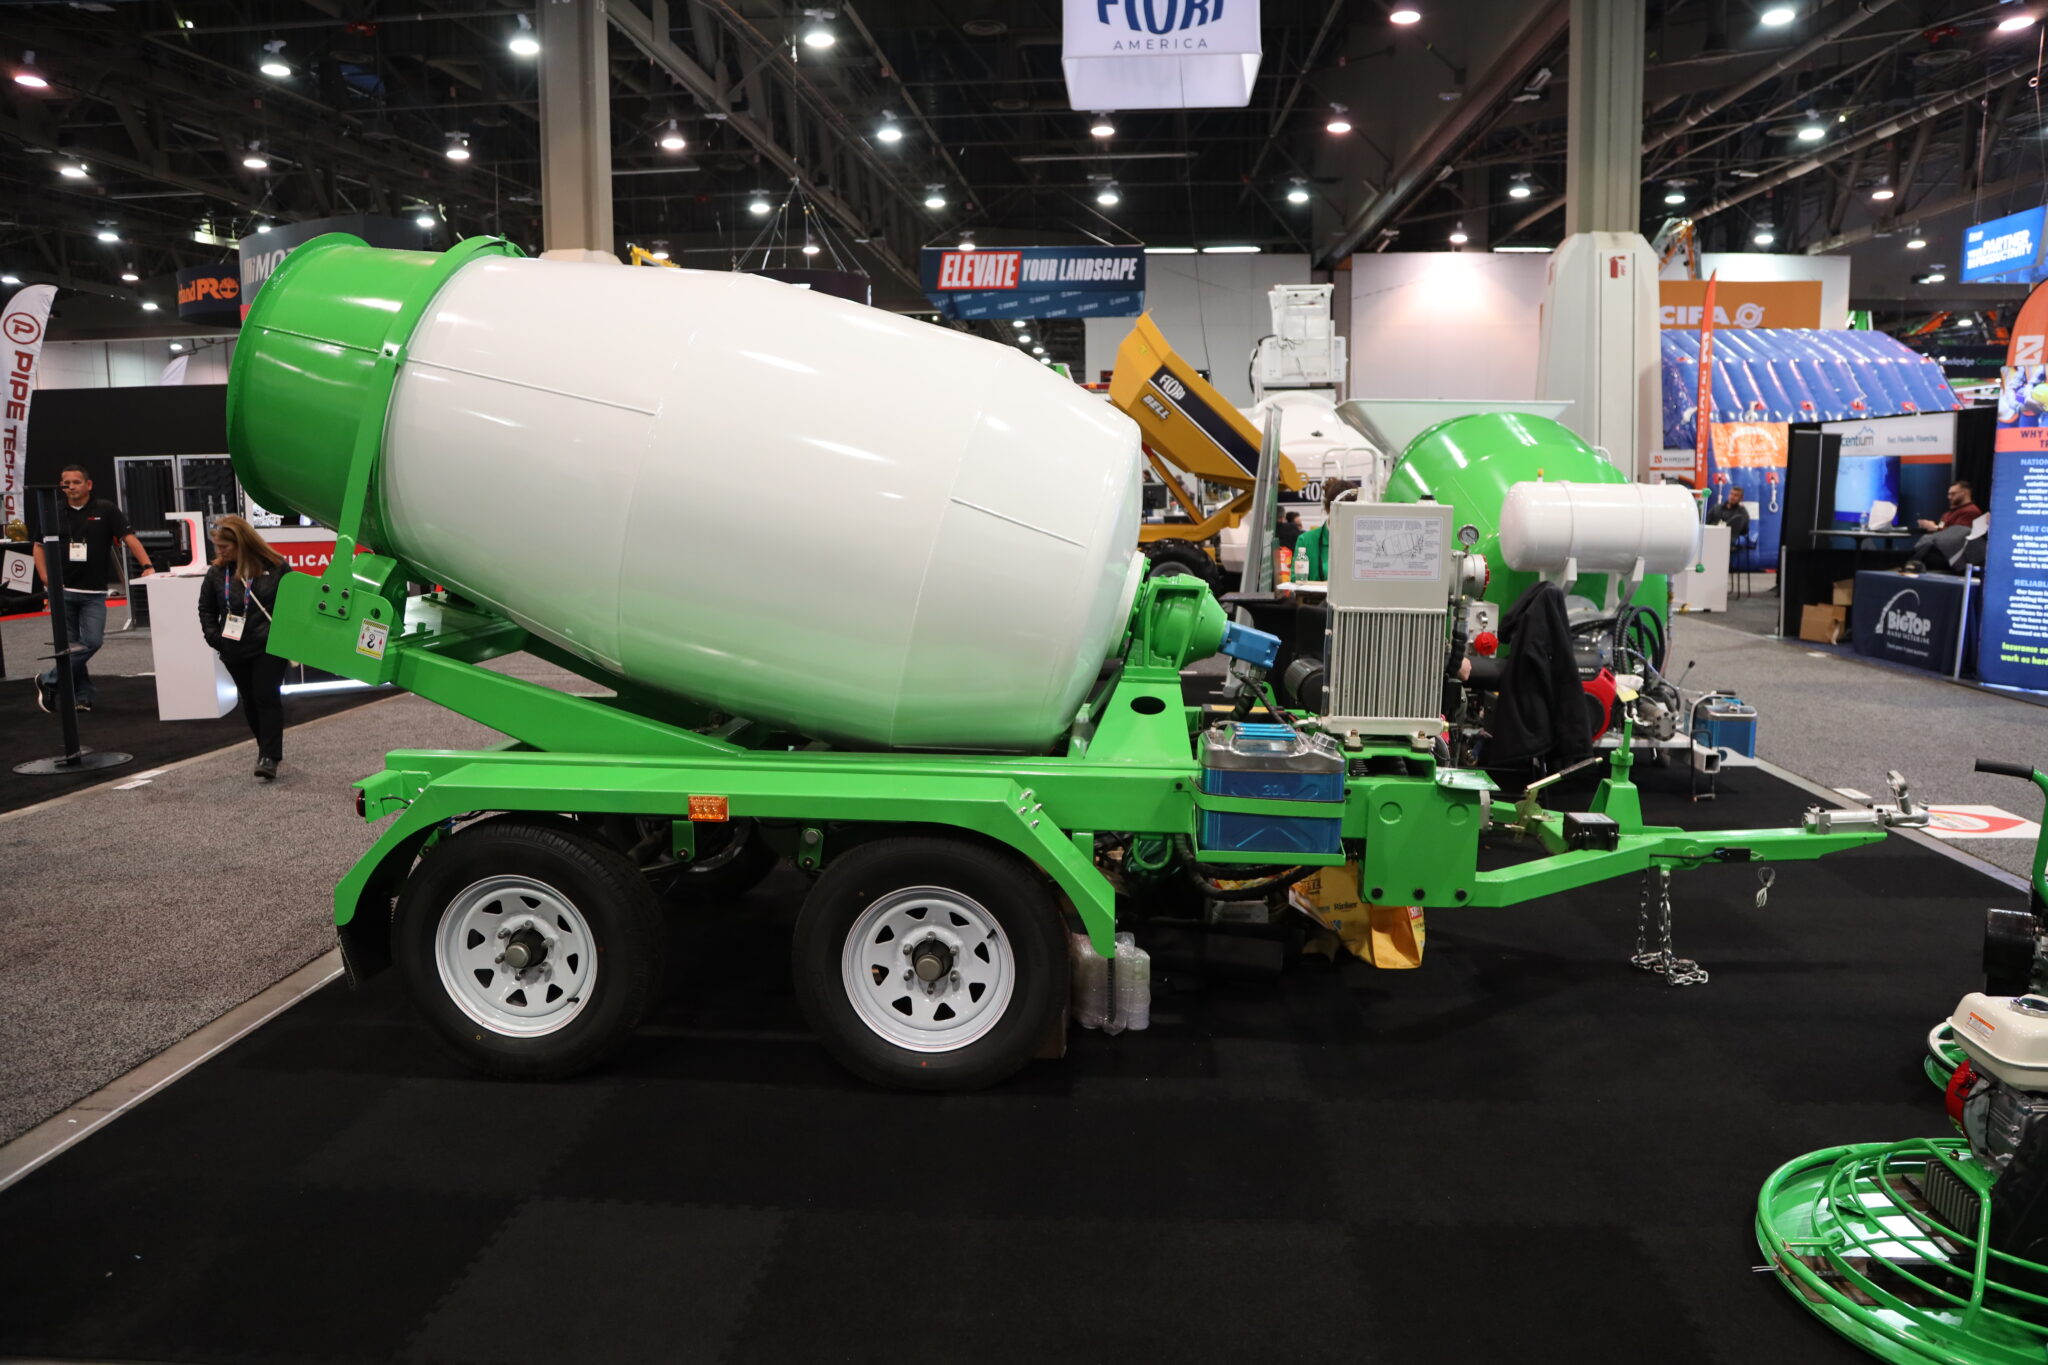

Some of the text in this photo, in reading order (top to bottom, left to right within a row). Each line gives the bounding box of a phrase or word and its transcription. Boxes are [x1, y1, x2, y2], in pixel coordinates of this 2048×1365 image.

[1113, 38, 1208, 51] AMERICA
[1983, 229, 2030, 256] PARTNER
[940, 254, 1138, 288] ELEVATE YOUR LANDSCAPE
[6, 350, 34, 421] PIPE
[1158, 374, 1186, 400] FIORI
[2020, 430, 2043, 438] WHY
[2020, 525, 2040, 533] FAST
[284, 553, 332, 567] LICA
[2002, 641, 2039, 654] Insurance
[2000, 654, 2020, 664] work
